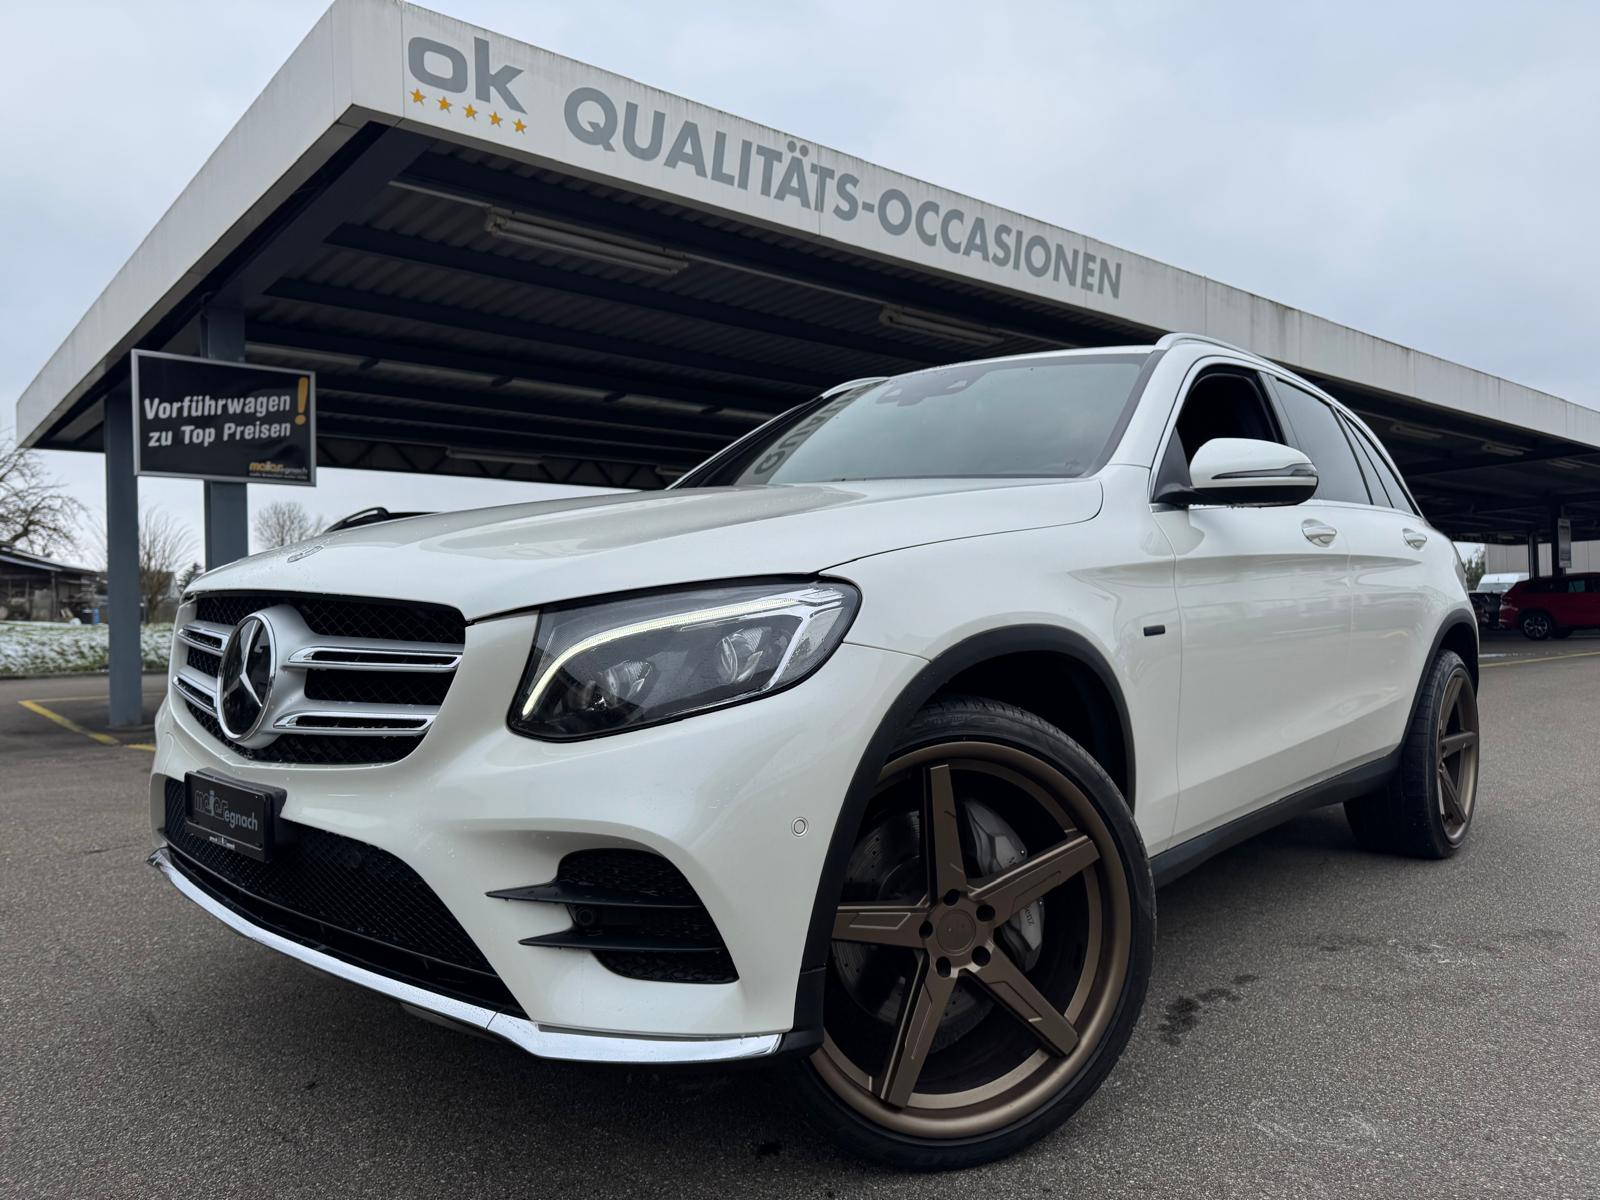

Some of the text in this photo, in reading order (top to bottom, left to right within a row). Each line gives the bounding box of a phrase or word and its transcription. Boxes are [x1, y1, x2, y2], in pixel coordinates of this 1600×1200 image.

[408, 36, 1122, 300] ok QUALITÄTS-OCCASIONEN
[144, 395, 290, 420] Vorführwagen
[148, 421, 291, 447] zu Top Preisen
